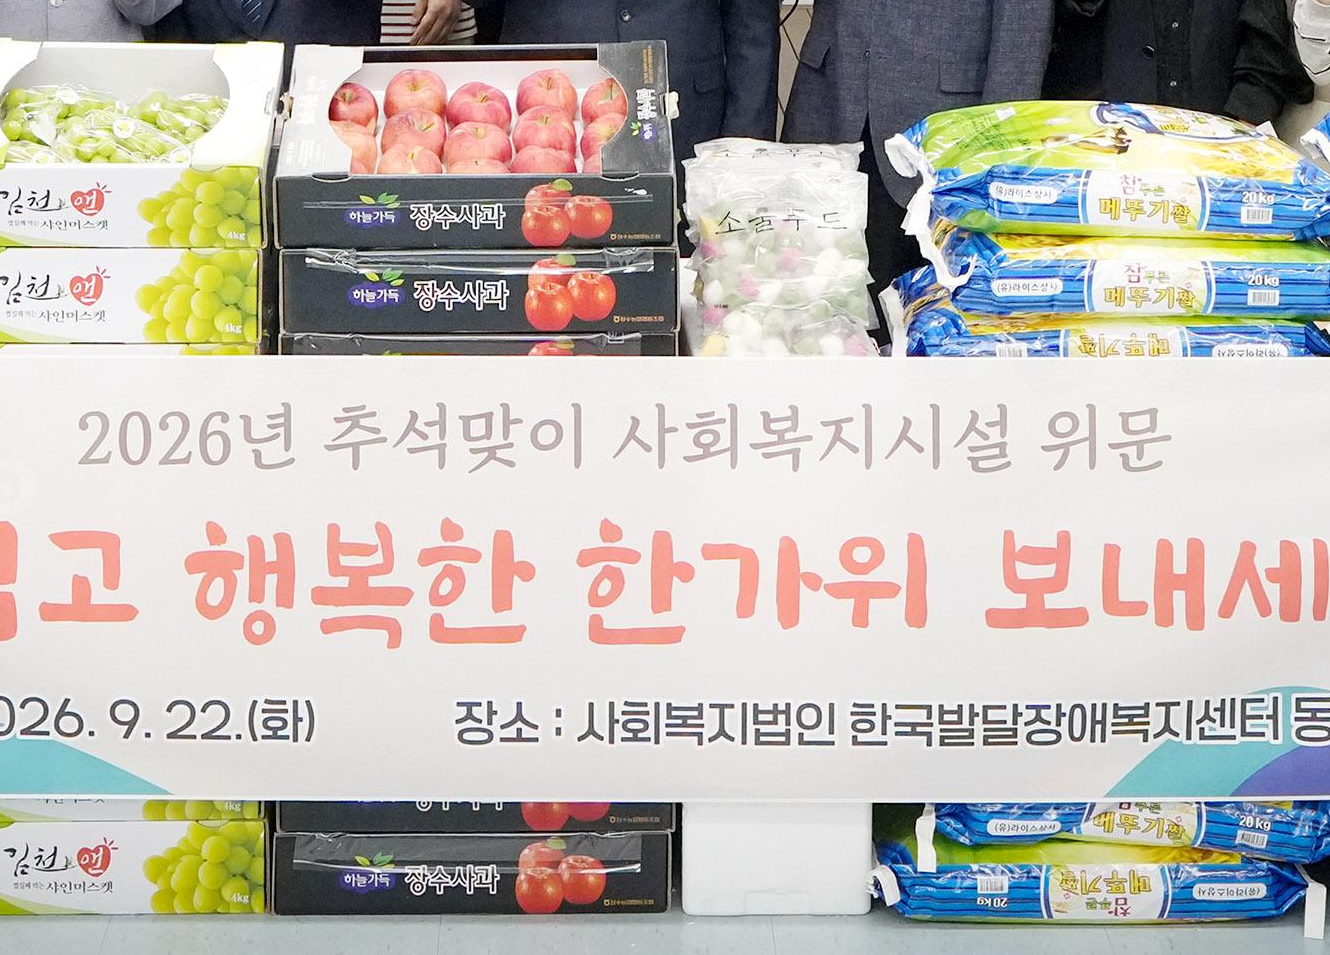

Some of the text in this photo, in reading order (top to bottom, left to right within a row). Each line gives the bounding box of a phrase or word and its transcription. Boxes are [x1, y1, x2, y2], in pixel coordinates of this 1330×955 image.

[349, 203, 506, 231] 하늘가득 장수사과
[1098, 197, 1191, 224] 메뚜기쌀
[228, 230, 247, 242] 4kg
[352, 280, 510, 311] 하늘가득 장수사과
[1103, 286, 1197, 309] 메뚜기쌀
[224, 322, 243, 334] 4kg
[78, 401, 1173, 474] 2026년 추석맞이 사회복지시설 위문
[183, 516, 537, 650] 행복한
[576, 516, 929, 646] 한가위
[454, 699, 541, 748] 장소
[576, 699, 836, 748] 사회복지법인
[848, 693, 1283, 748] 한국발달장애복지센터
[223, 801, 242, 813] 4kg
[343, 864, 500, 895] 하늘가득 장수사과
[230, 893, 250, 905] 4kg
